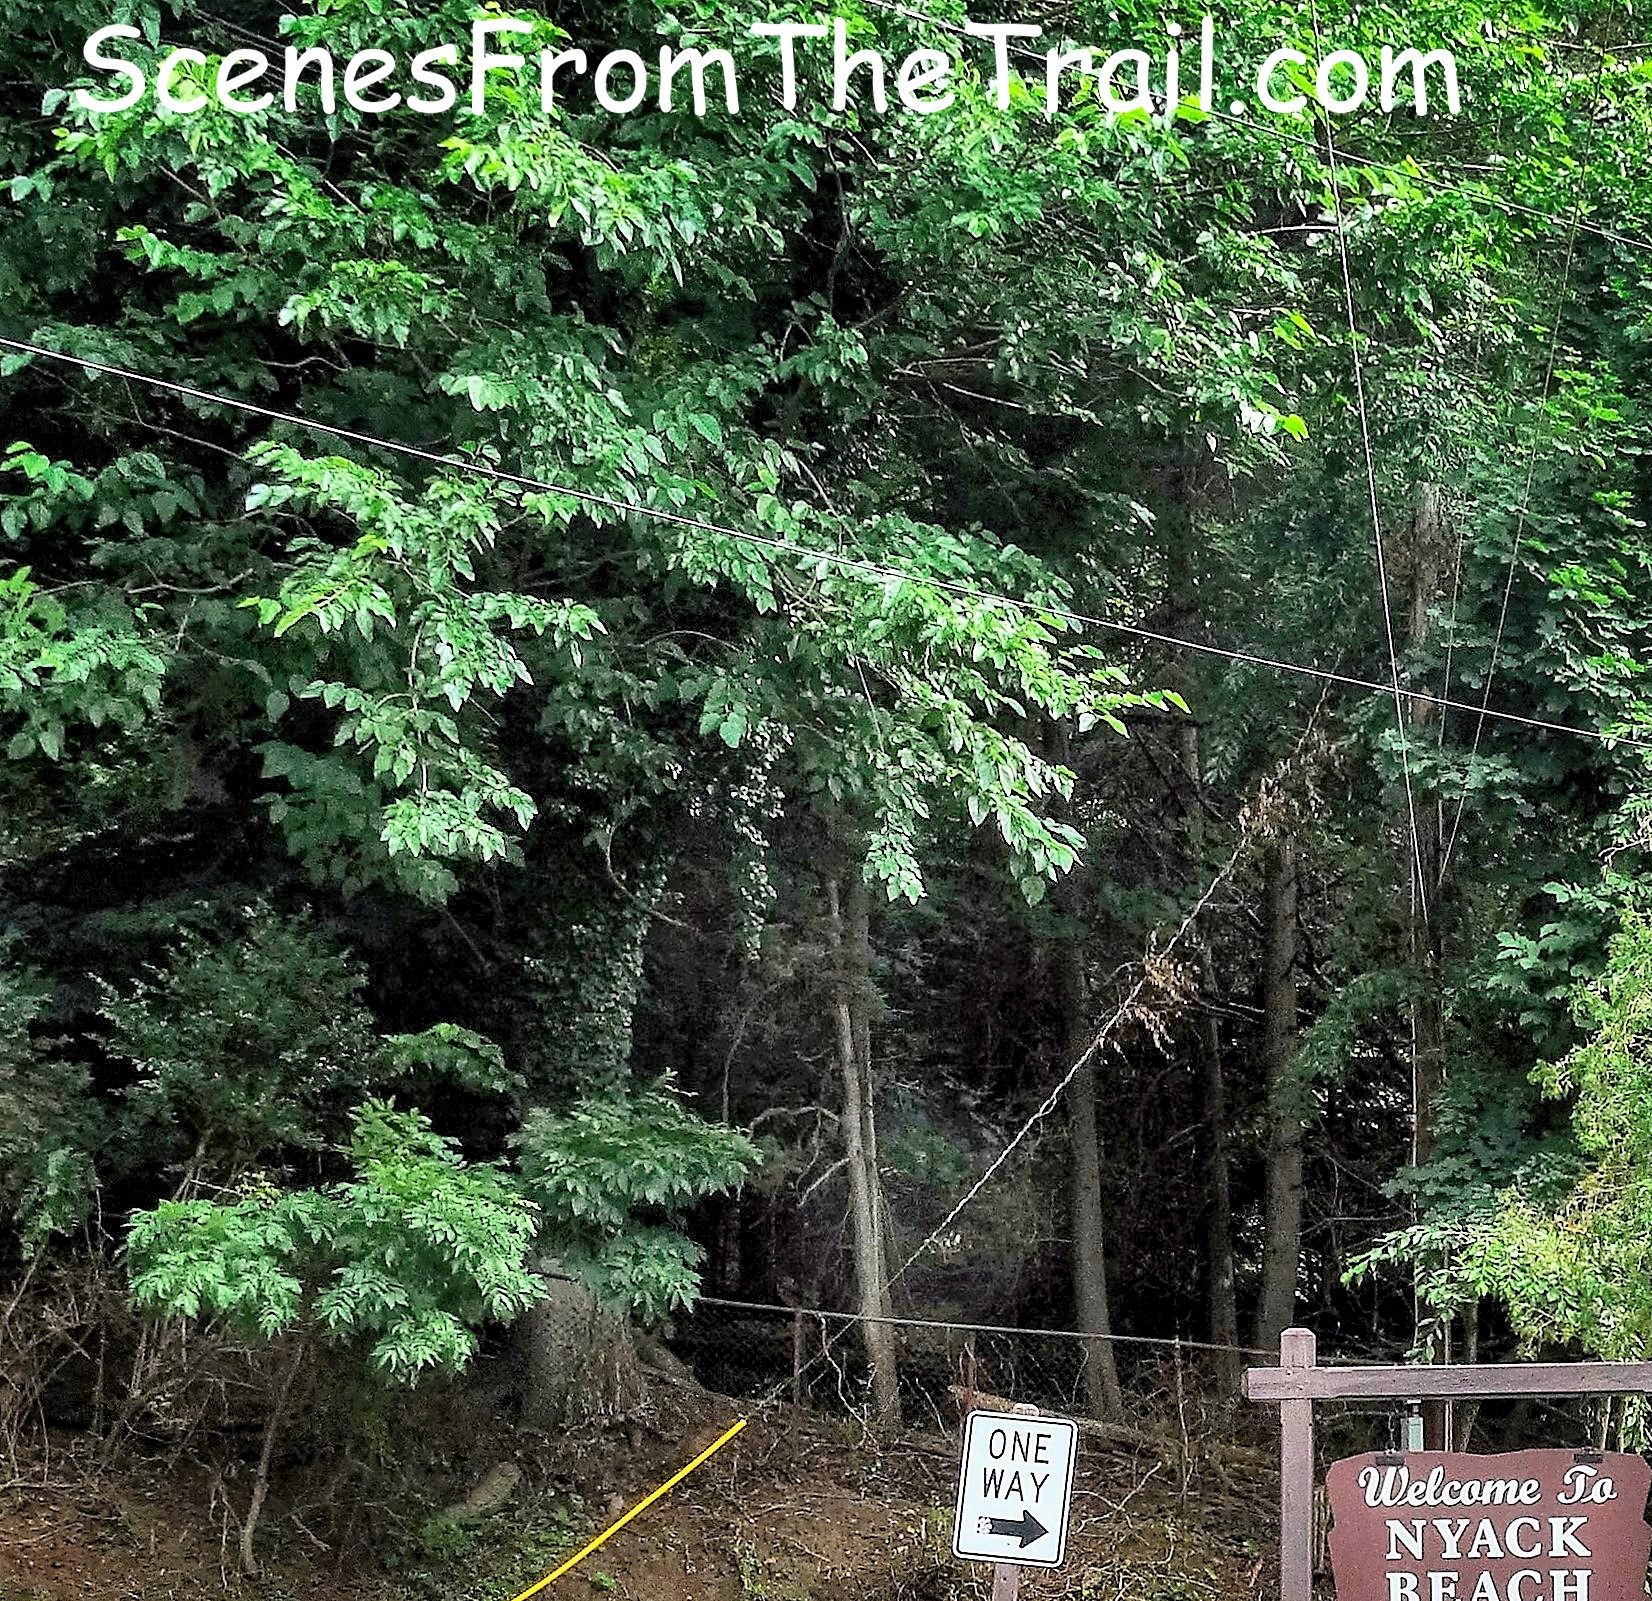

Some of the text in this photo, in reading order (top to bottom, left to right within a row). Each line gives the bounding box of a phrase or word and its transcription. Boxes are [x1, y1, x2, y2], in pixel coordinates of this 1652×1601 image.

[989, 1428, 1052, 1465] ONE
[983, 1467, 1050, 1504] WAY
[1358, 1464, 1618, 1507] Welcome To
[1384, 1515, 1593, 1560] NYACK
